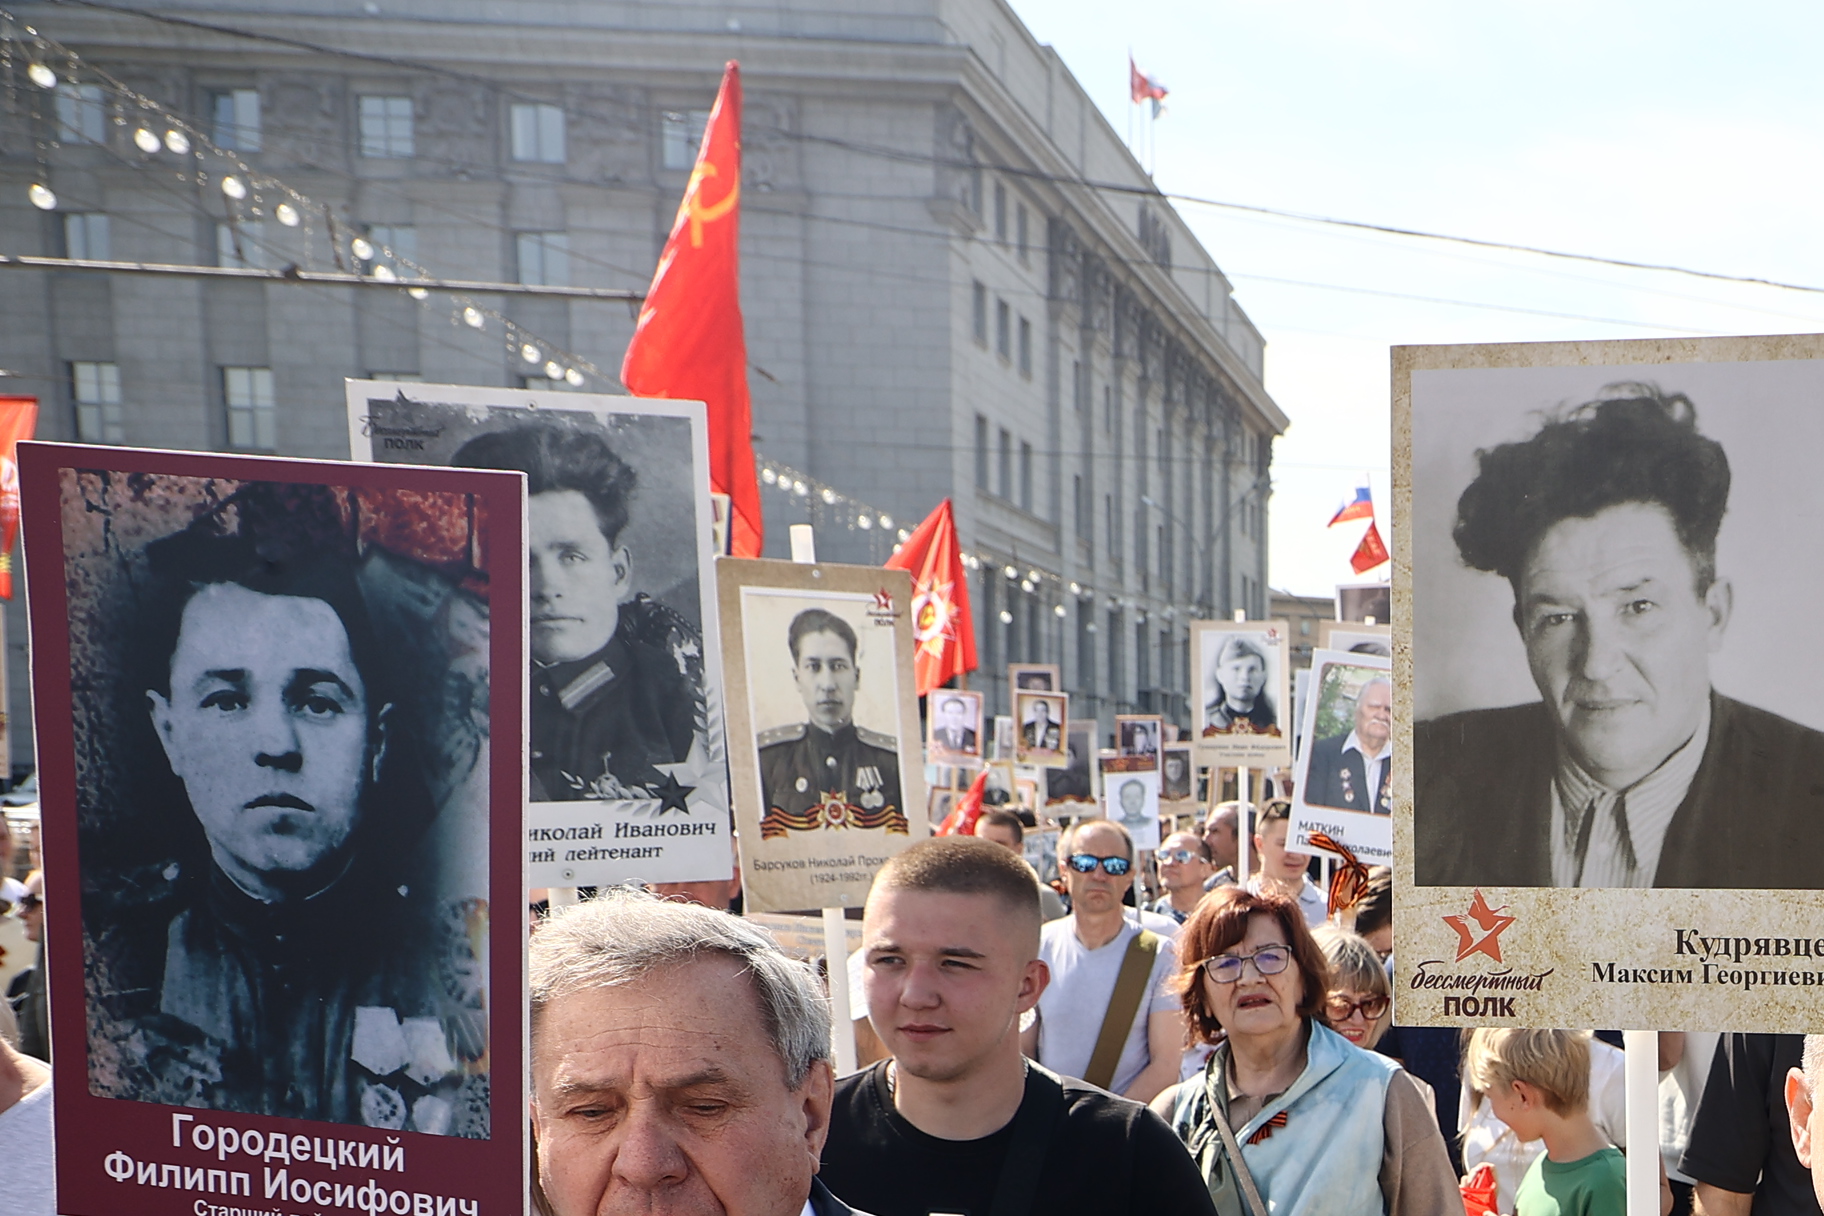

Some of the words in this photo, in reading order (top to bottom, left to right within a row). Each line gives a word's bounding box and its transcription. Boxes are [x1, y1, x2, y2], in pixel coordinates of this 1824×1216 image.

[384, 438, 424, 450] ПОЛК
[529, 823, 603, 841] иколай
[615, 822, 716, 838] Иванович
[1298, 820, 1345, 836] МАТКИН
[565, 846, 663, 861] лейтенант
[753, 859, 805, 871] Барсуков
[808, 855, 855, 867] Николай
[1591, 962, 1693, 984] Максим
[1444, 996, 1516, 1017] ПОЛК
[171, 1113, 406, 1172] Городецкий
[103, 1150, 250, 1197] Филипп
